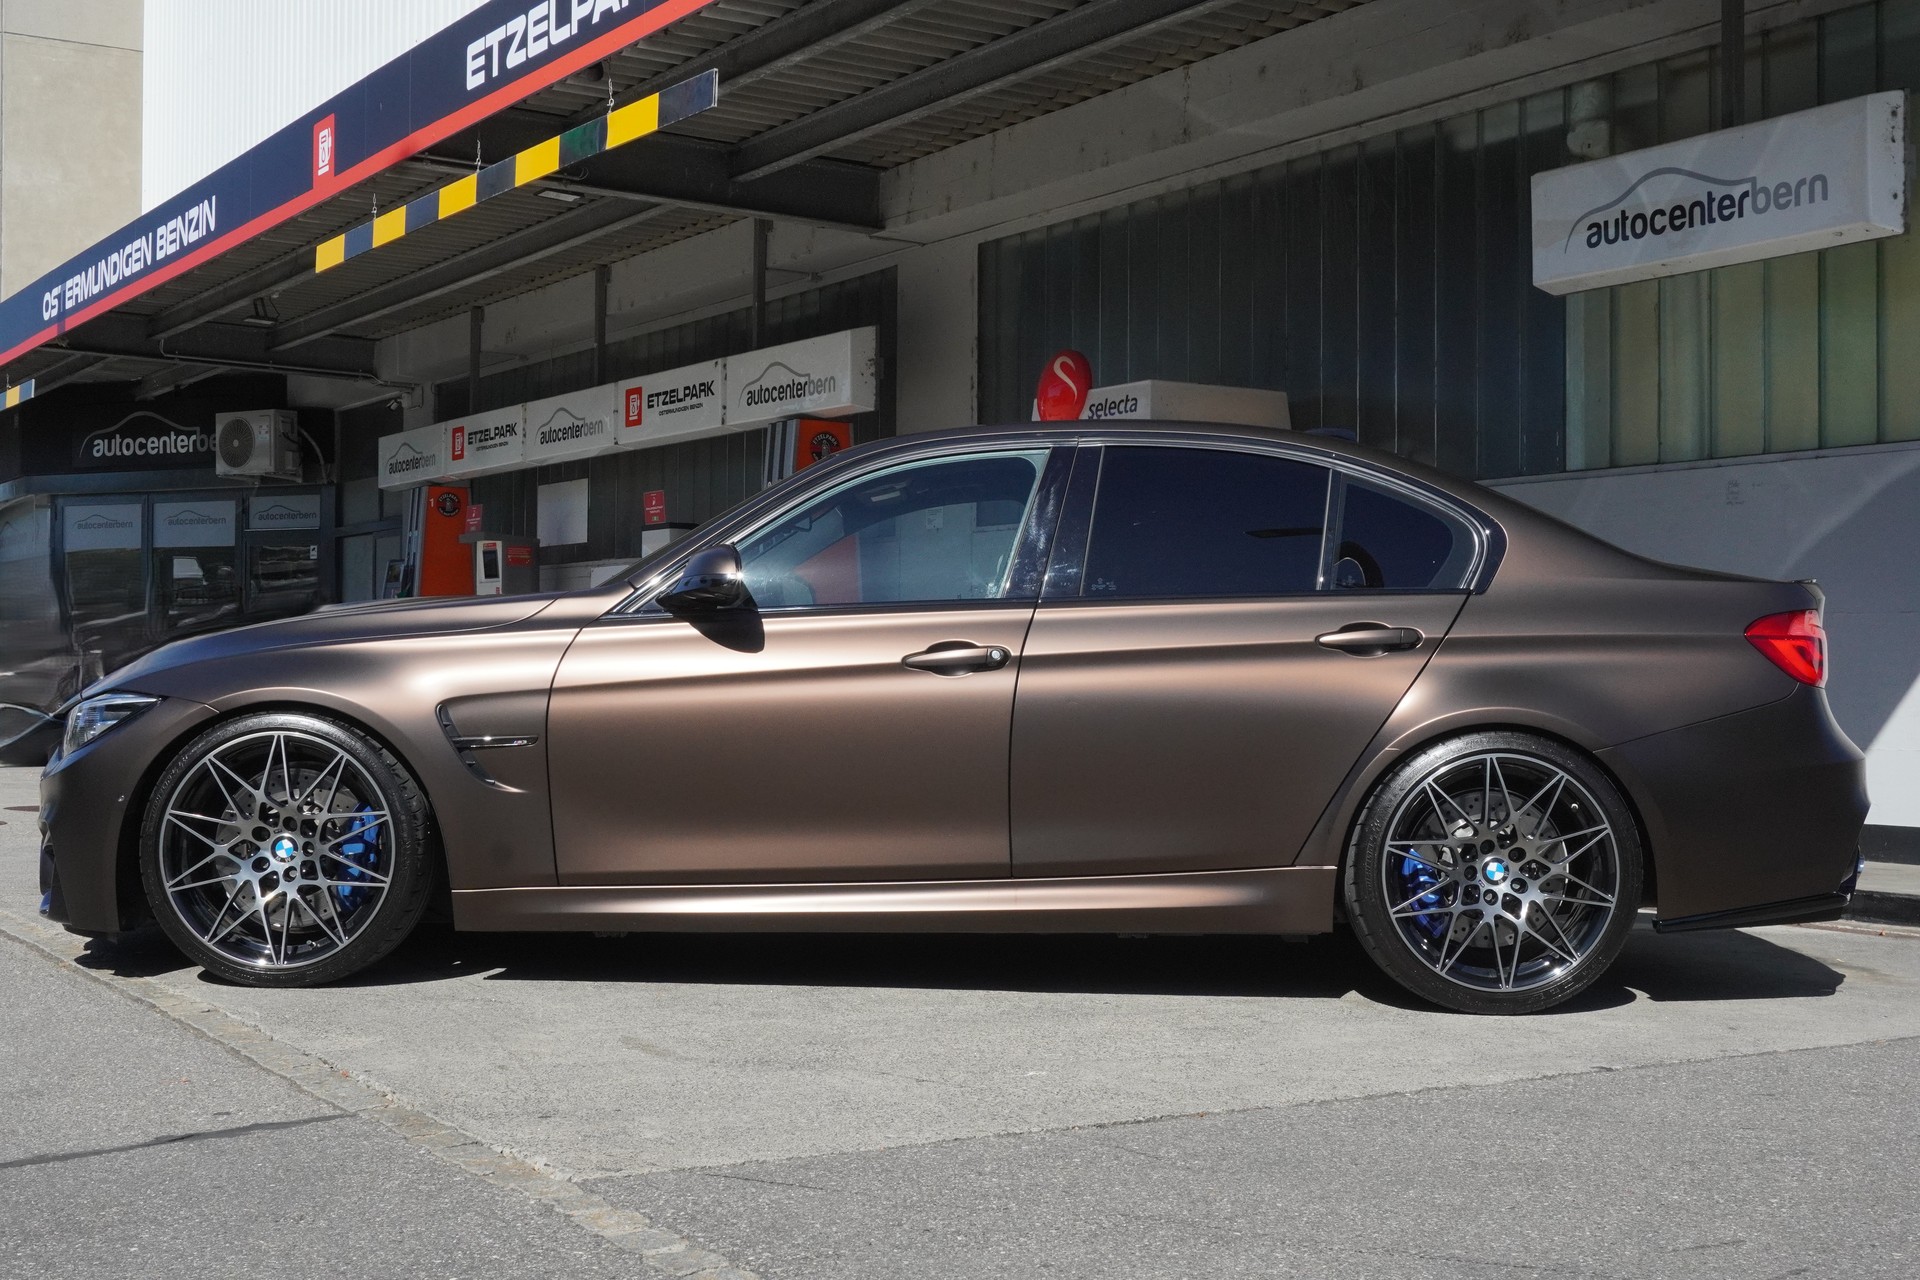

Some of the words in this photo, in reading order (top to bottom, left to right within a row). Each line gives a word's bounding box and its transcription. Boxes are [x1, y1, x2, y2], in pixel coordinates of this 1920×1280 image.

[466, 0, 629, 90] ETZELP
[1586, 173, 1828, 248] autocenterbern
[42, 233, 152, 321] OSTERMUNDIGEN
[156, 195, 216, 261] BENZIN
[647, 380, 715, 409] ETZELPARK
[746, 376, 837, 407] autocenterbern
[1088, 394, 1138, 418] selecta
[468, 422, 517, 445] ETZELPARK
[540, 419, 604, 446] autocenterbern
[389, 454, 435, 474] autocenterbern
[430, 498, 434, 507] 1
[77, 519, 133, 530] autocenterbern
[168, 515, 227, 526] autocenterbern
[257, 511, 317, 520] autocenterbern
